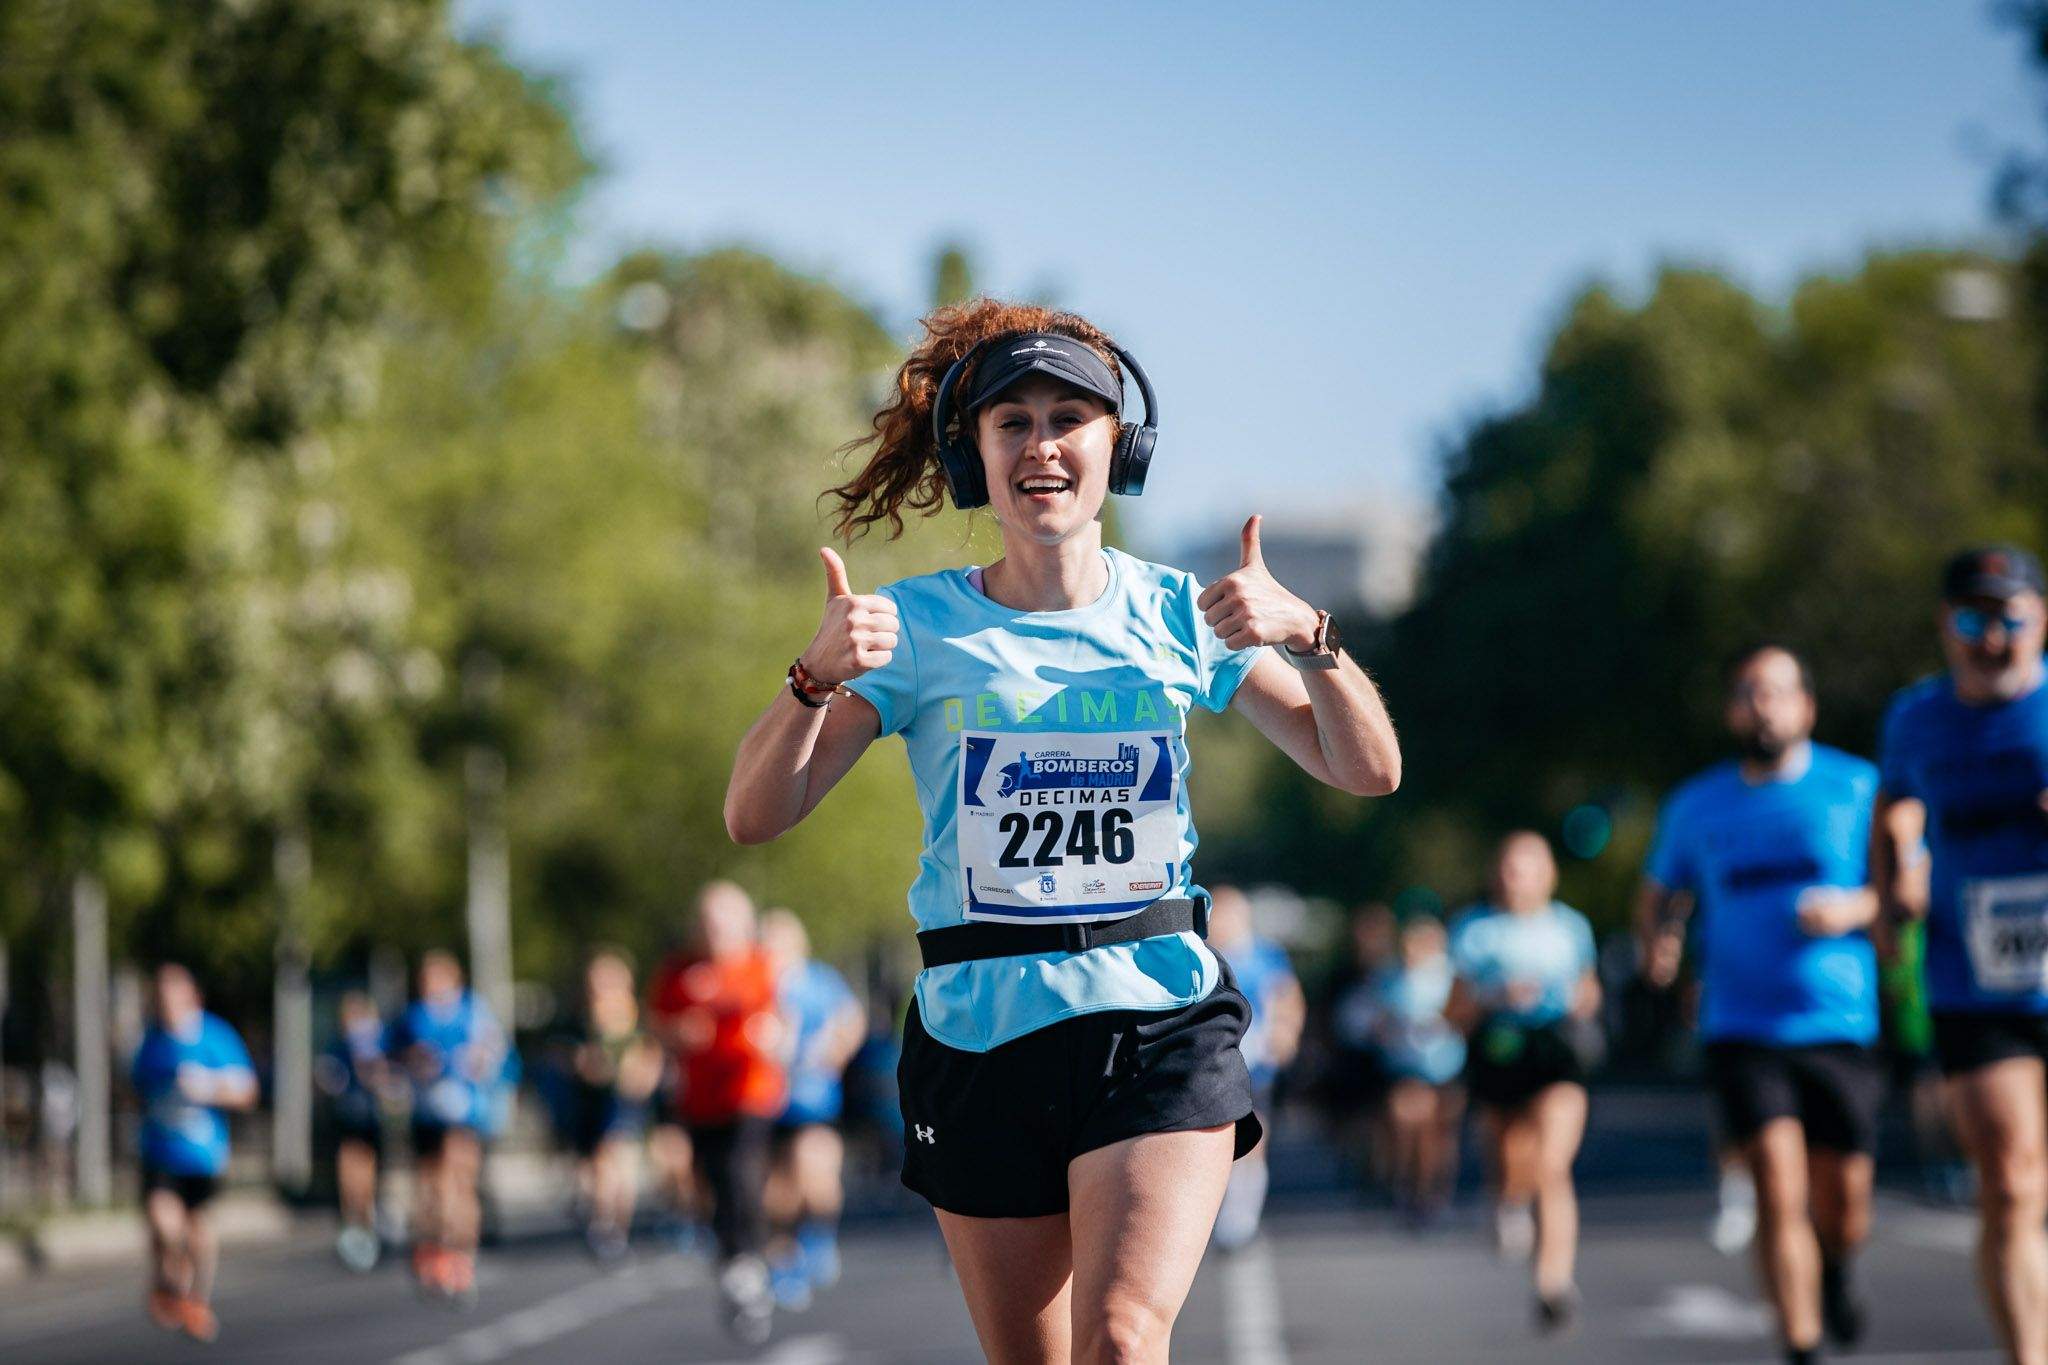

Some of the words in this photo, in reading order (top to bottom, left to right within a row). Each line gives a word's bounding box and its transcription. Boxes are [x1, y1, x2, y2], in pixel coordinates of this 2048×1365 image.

[1033, 760, 1134, 773] BOMBEROS
[1070, 775, 1085, 787] de
[1088, 774, 1134, 786] MADRID
[1020, 789, 1130, 806] DECIMAS
[999, 808, 1135, 867] 2246
